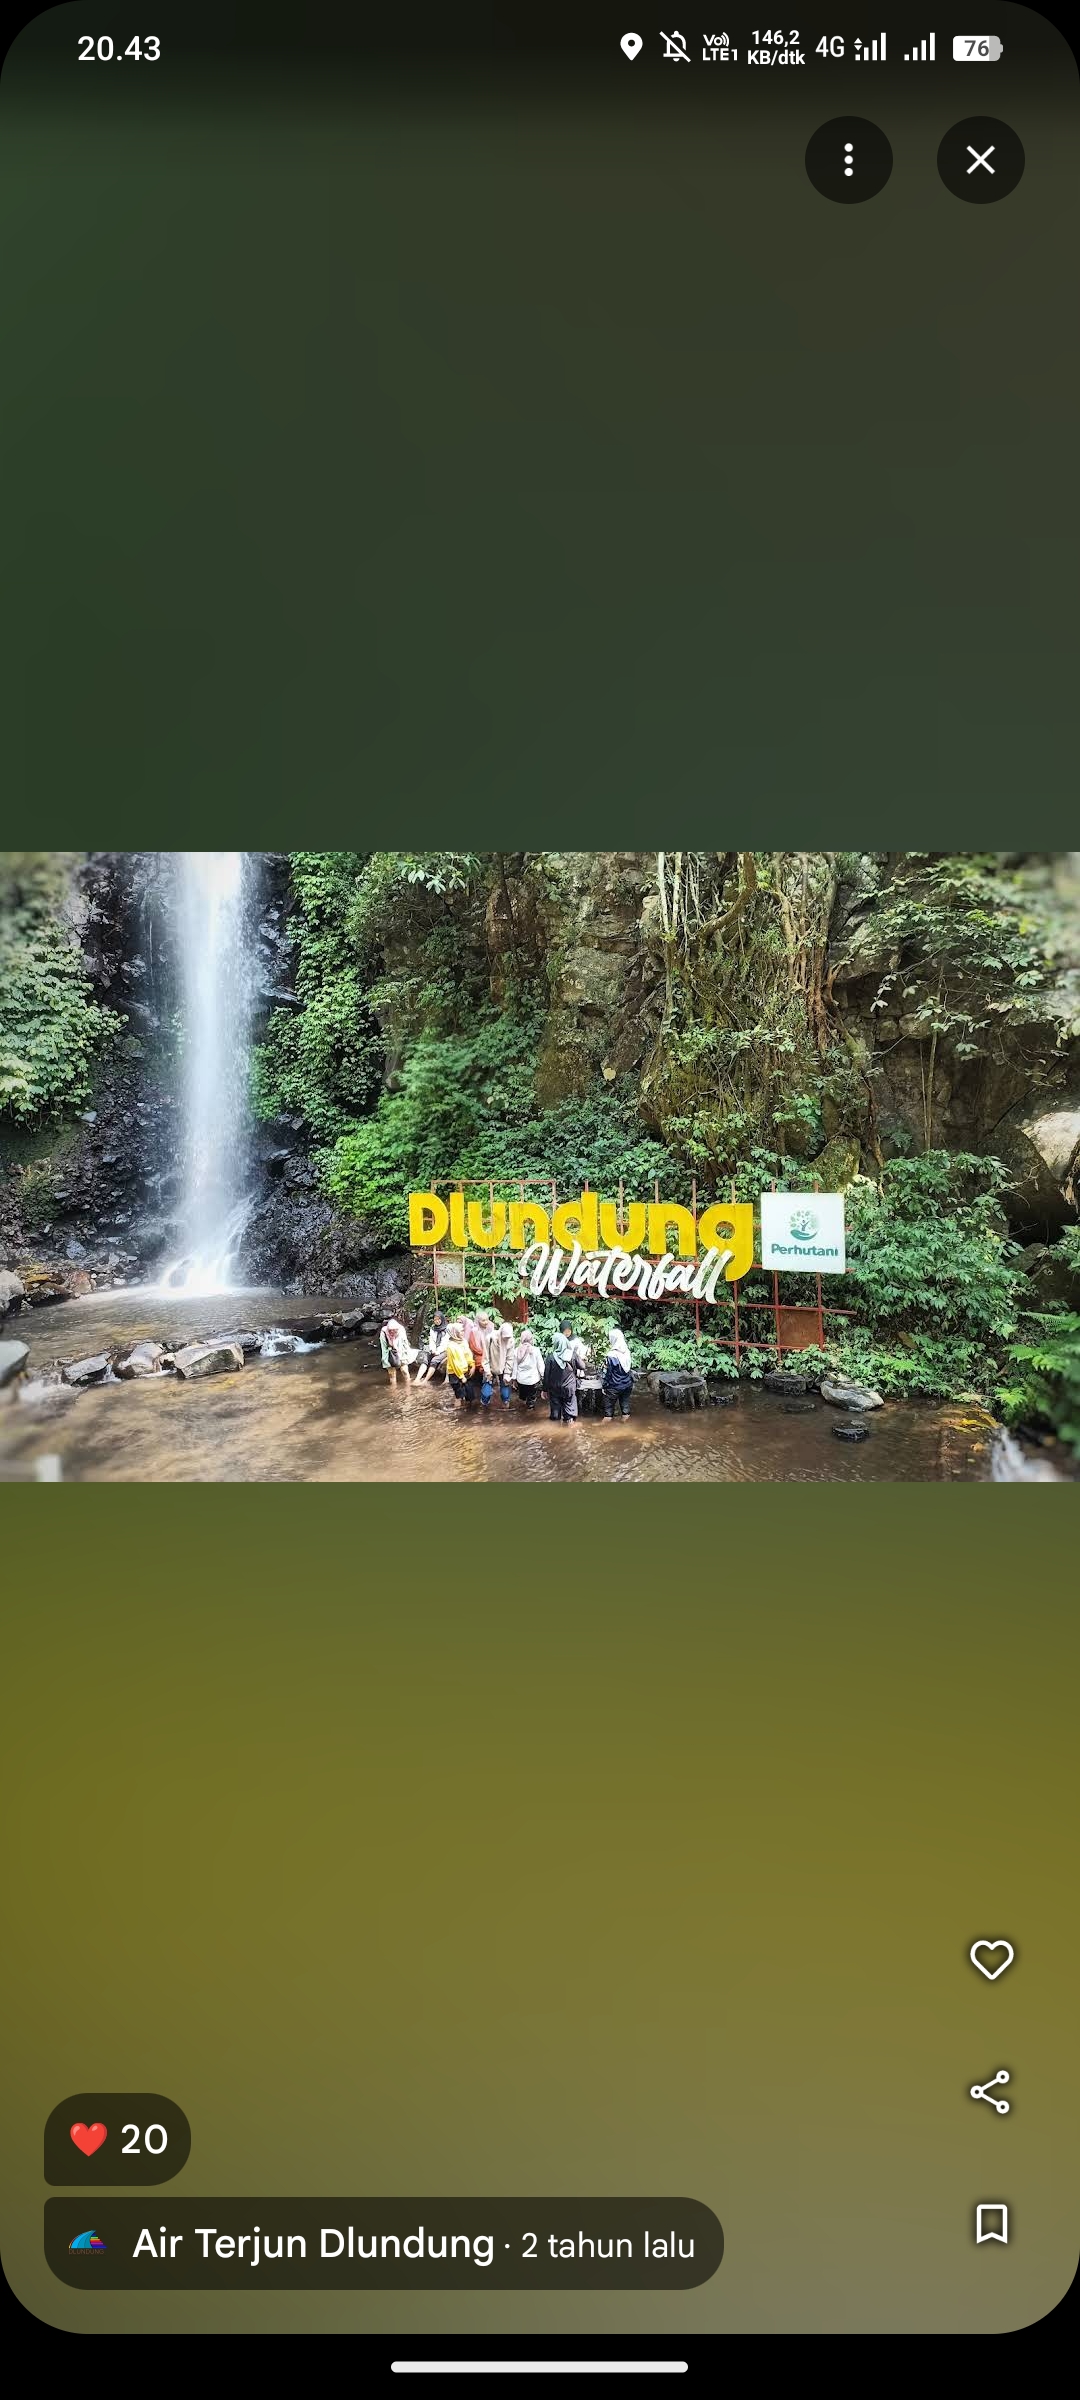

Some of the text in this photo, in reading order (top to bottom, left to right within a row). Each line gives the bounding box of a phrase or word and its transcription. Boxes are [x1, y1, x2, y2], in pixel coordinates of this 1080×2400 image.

[408, 1191, 754, 1283] Dlundung
[771, 1243, 839, 1257] Perhutani
[518, 1240, 735, 1305] Waterfall
